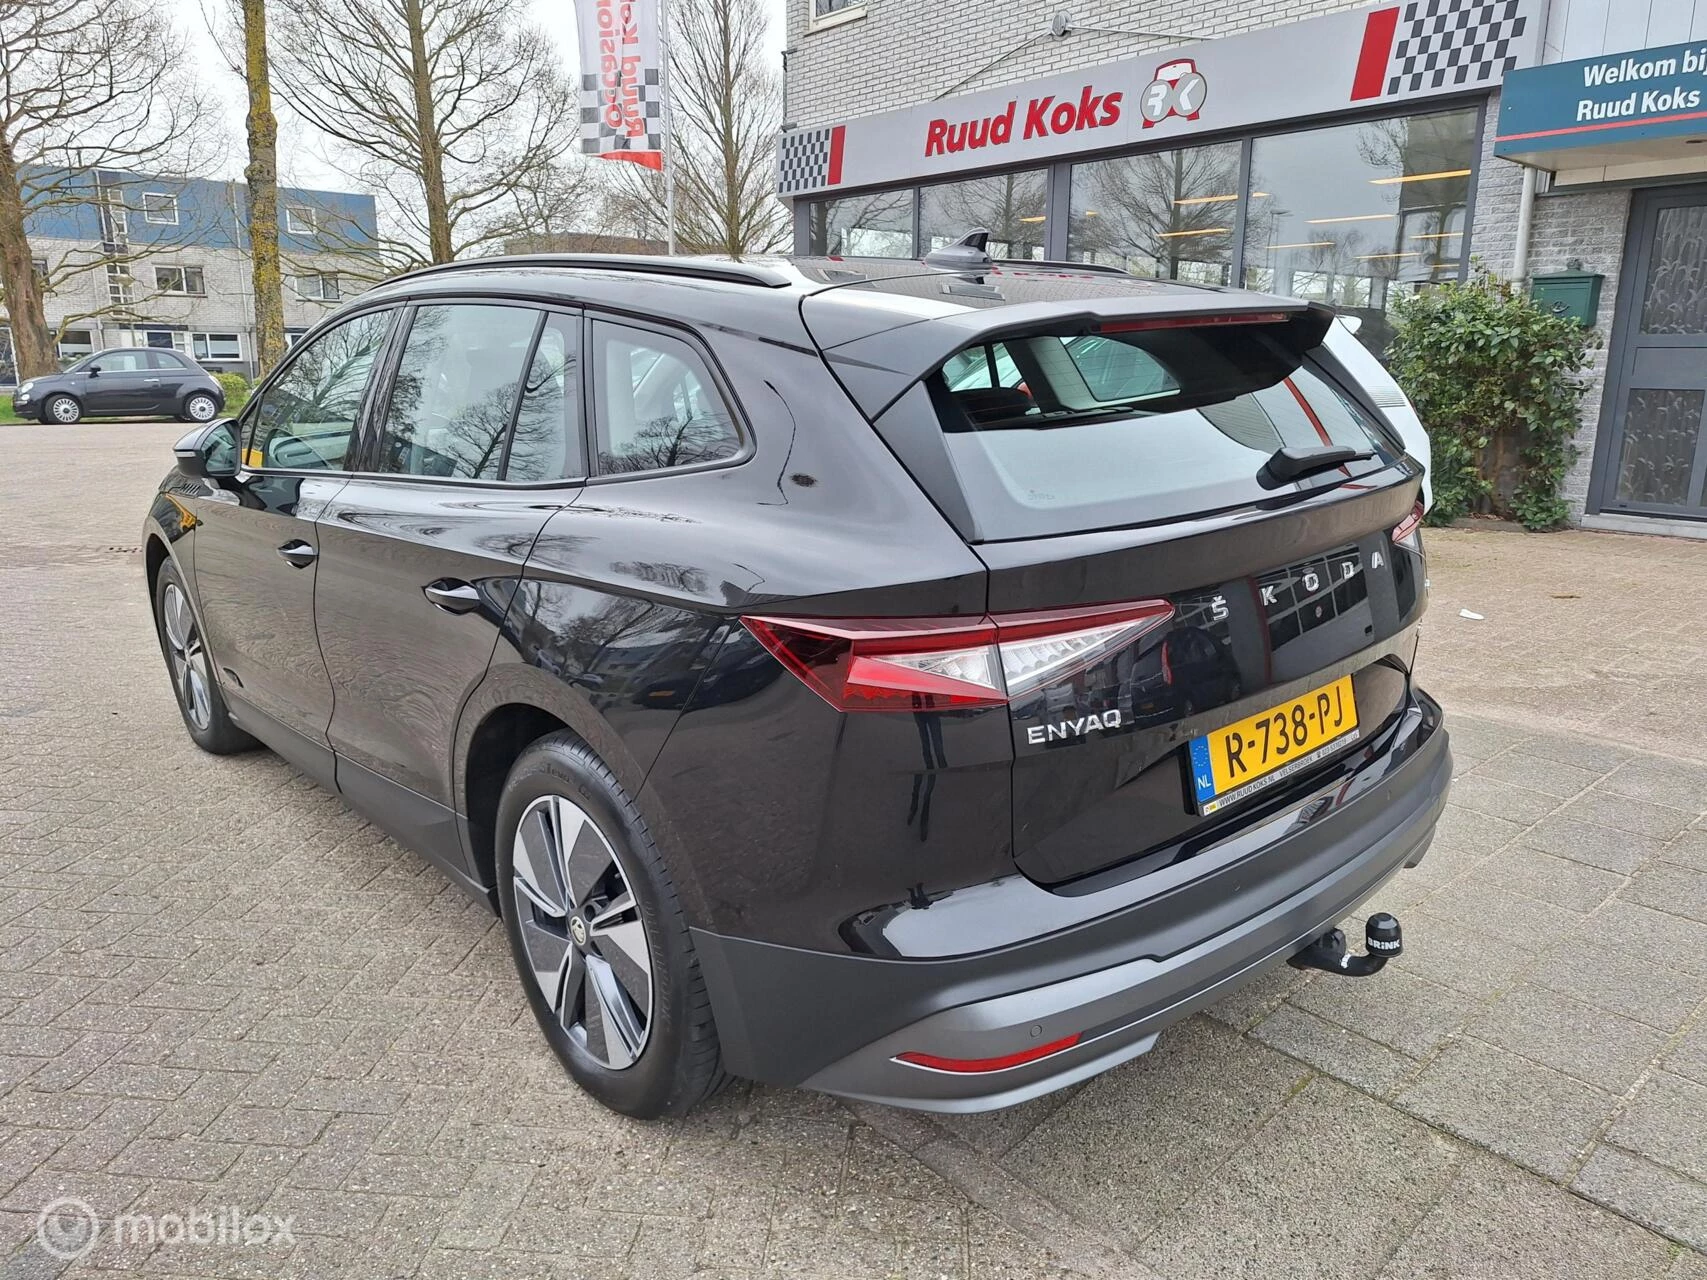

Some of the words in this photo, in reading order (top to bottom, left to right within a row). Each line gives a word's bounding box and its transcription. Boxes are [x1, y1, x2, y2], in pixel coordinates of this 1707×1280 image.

[1583, 58, 1676, 87] Welkom
[925, 101, 1017, 157] Ruud
[1023, 85, 1123, 140] Koks
[1576, 92, 1638, 122] Ruud
[1640, 86, 1701, 114] Koks
[1027, 709, 1121, 744] ENYAQ
[1225, 685, 1343, 778] R-738-PJ
[1197, 774, 1212, 790] NL
